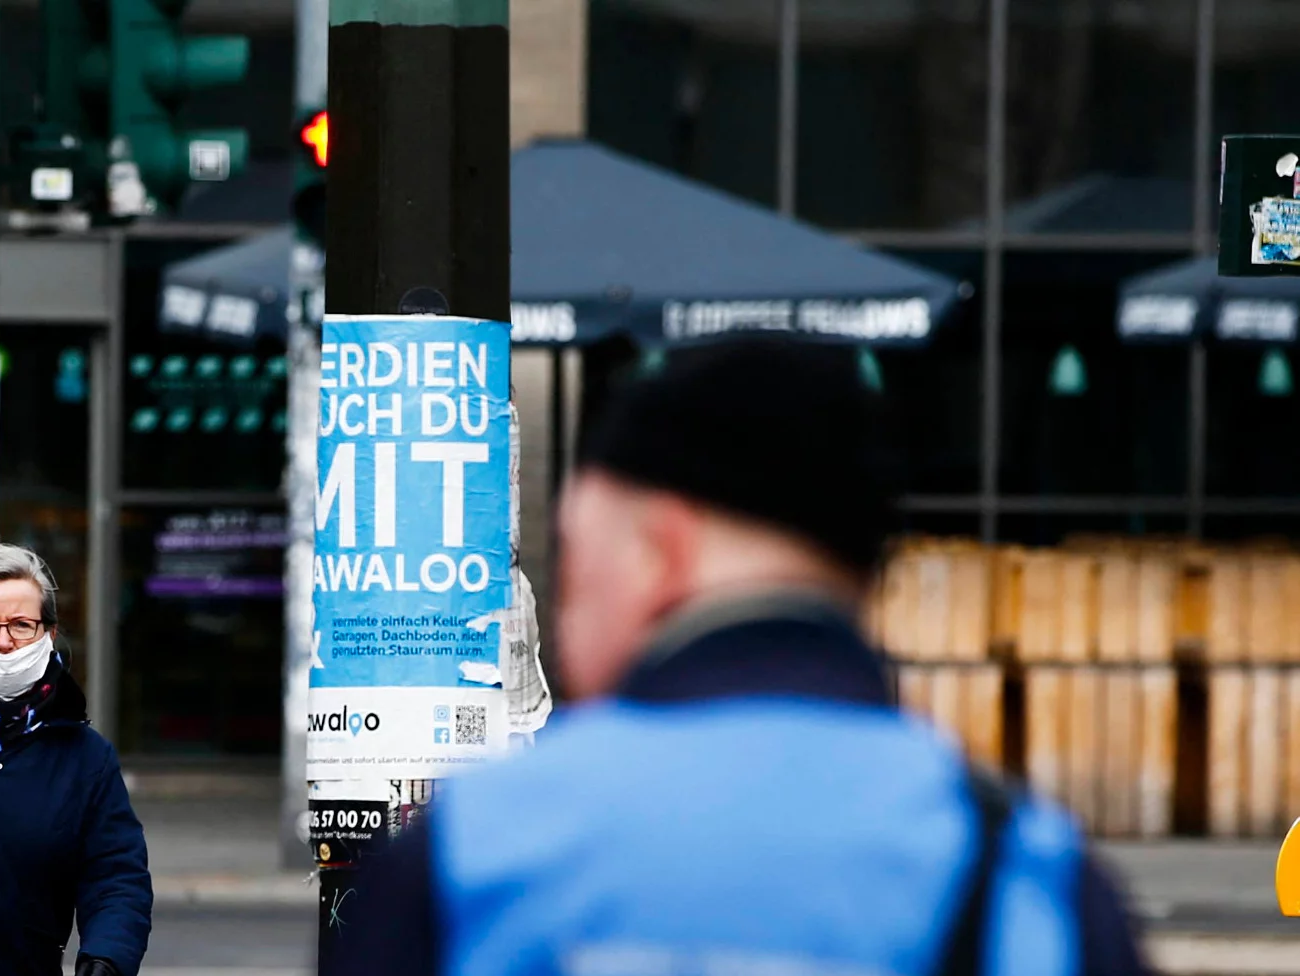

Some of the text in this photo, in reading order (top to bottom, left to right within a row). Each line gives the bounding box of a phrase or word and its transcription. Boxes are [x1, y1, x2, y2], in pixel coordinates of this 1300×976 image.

[320, 342, 487, 388] ERDIEN
[320, 392, 490, 436] UCH DU
[313, 553, 490, 592] AWALOO
[332, 616, 378, 628] vermiete
[381, 615, 429, 628] einfach
[332, 629, 378, 643] Garagen,
[381, 628, 460, 642] Dachboden,
[332, 645, 385, 659] genutzten
[388, 643, 452, 657] Stauraum
[321, 809, 334, 828] 57
[337, 809, 358, 828] 00
[361, 810, 382, 829] 70
